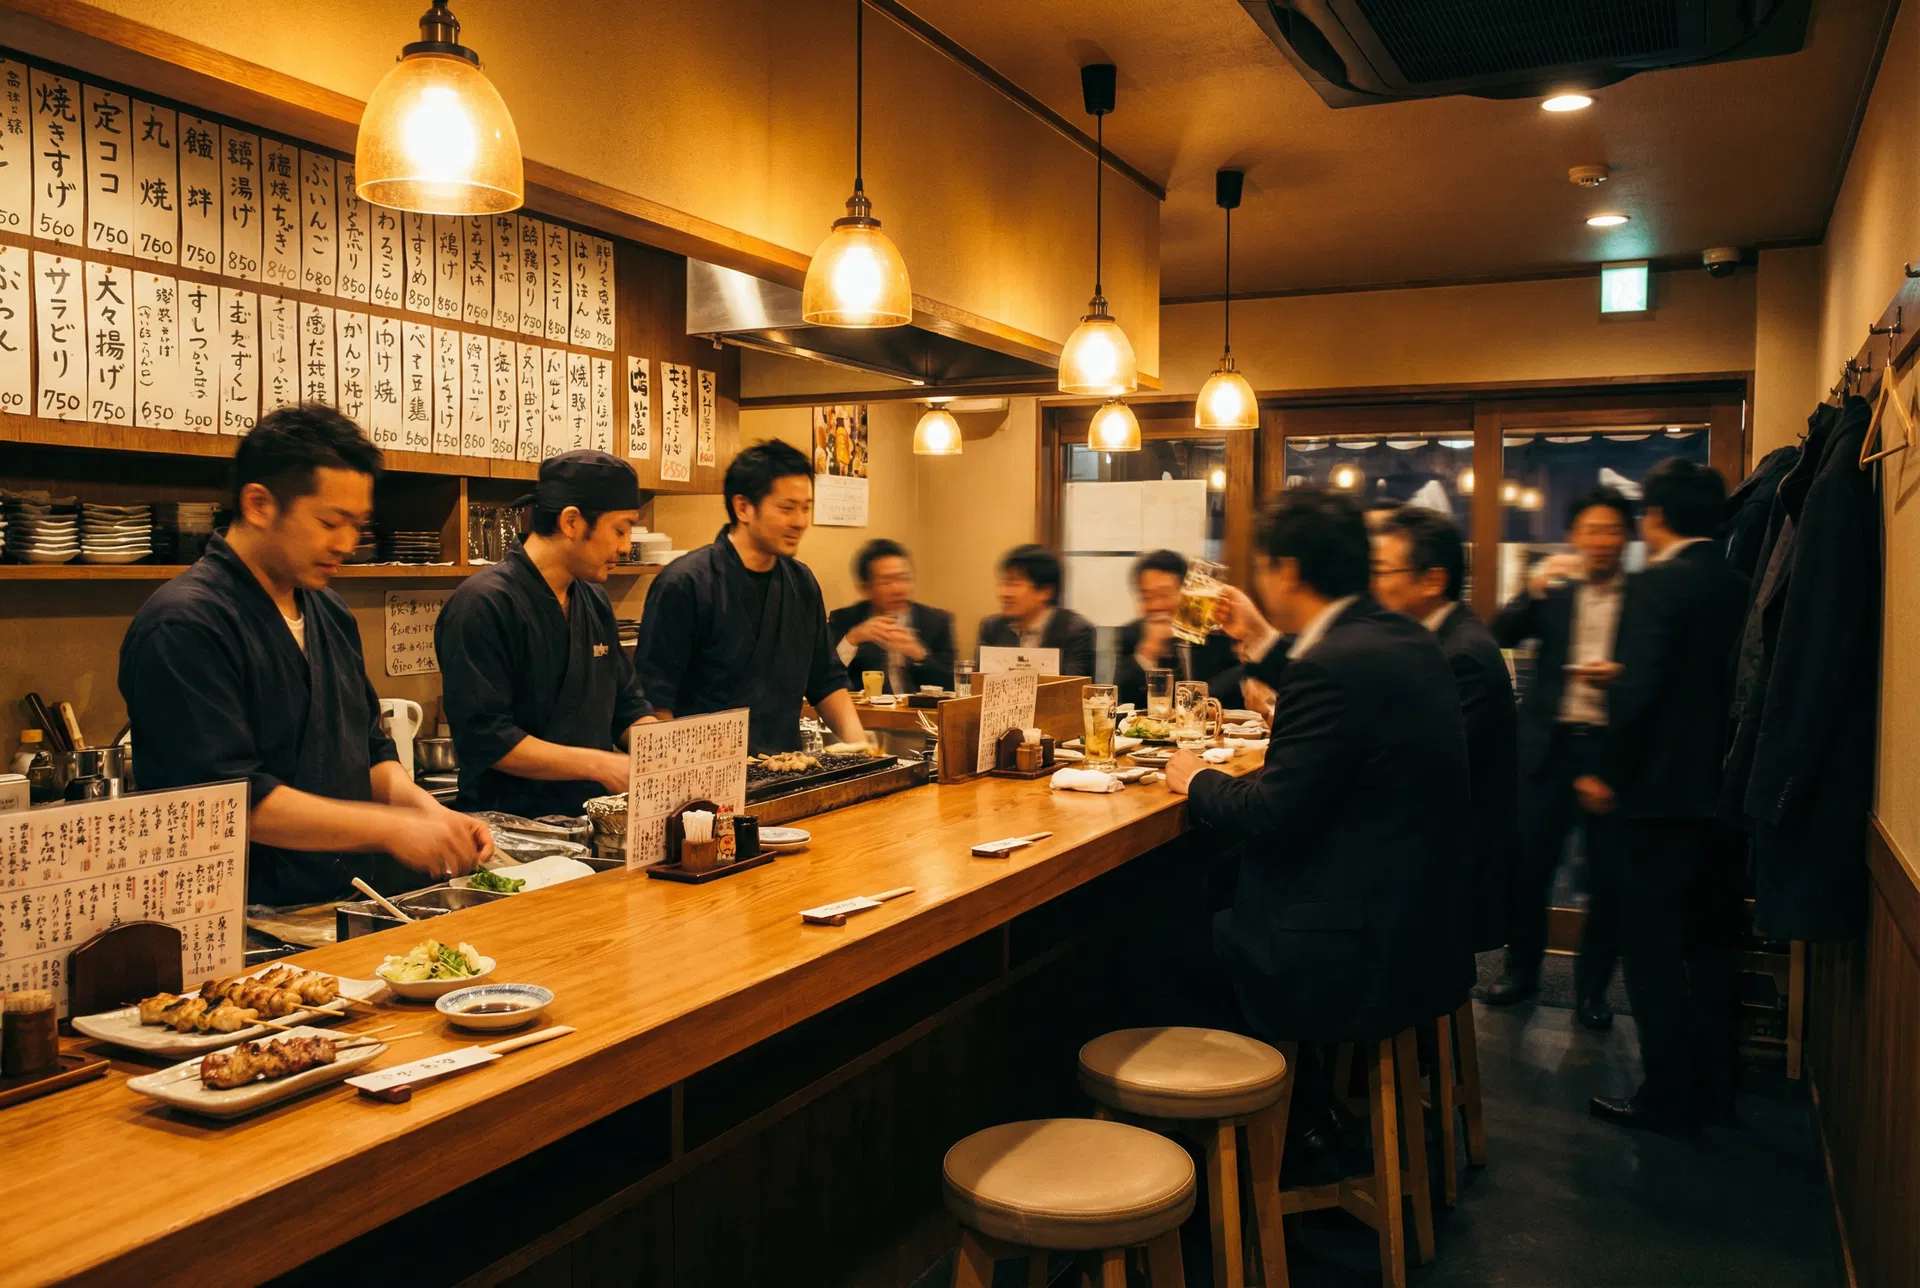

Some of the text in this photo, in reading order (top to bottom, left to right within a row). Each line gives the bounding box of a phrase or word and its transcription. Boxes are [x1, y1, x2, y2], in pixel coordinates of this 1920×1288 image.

[36, 83, 77, 208] 焼きすげ
[93, 99, 124, 194] 定ココ
[39, 212, 75, 238] 560
[93, 221, 129, 245] 750
[140, 232, 173, 255] 760
[187, 244, 216, 264] 750
[228, 251, 257, 272] 850
[266, 260, 297, 281] 840
[305, 267, 332, 286] 680
[341, 274, 366, 294] 850
[408, 289, 430, 307] 850
[437, 294, 458, 311] 850
[44, 267, 76, 379] サラどり
[95, 274, 126, 391] 大々揚げ
[43, 389, 80, 411] 750
[92, 400, 126, 420] 750
[141, 400, 174, 420] 650
[223, 409, 255, 429] 590
[631, 439, 647, 451] 600
